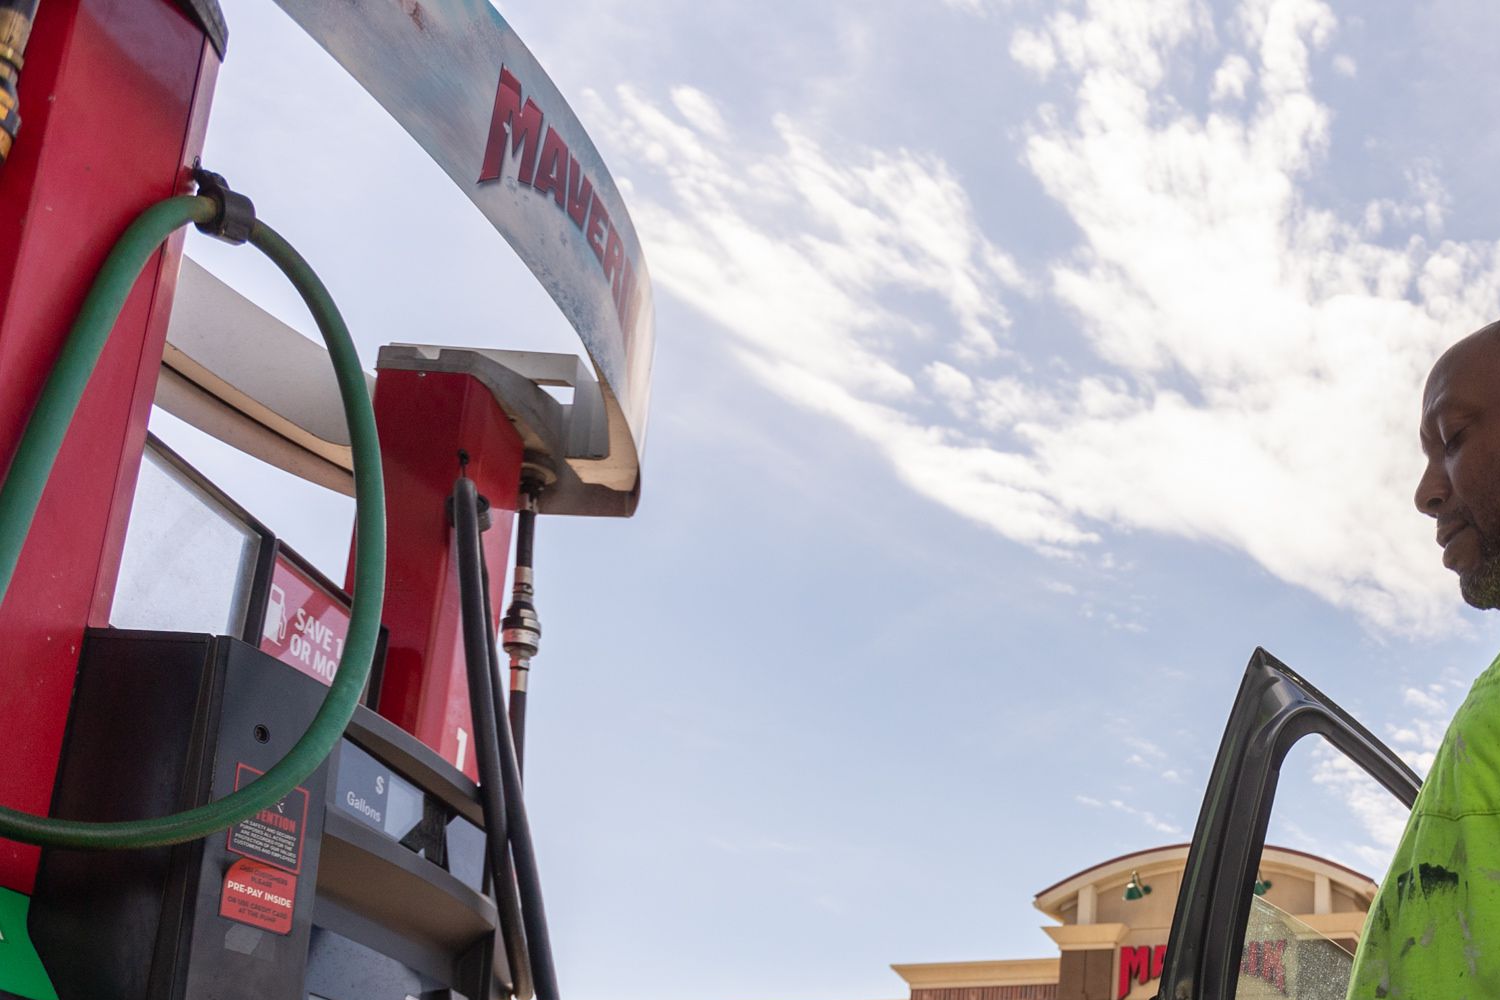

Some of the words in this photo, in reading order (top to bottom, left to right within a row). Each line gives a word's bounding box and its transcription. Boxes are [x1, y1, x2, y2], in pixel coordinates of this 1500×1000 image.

[294, 608, 333, 652] SAVE
[290, 634, 311, 665] OR
[312, 651, 337, 682] MO
[456, 727, 467, 771] 1
[255, 810, 295, 833] TENTION
[347, 791, 381, 822] Gallons
[227, 880, 263, 898] PRE-PAY
[264, 892, 292, 908] INSIDE
